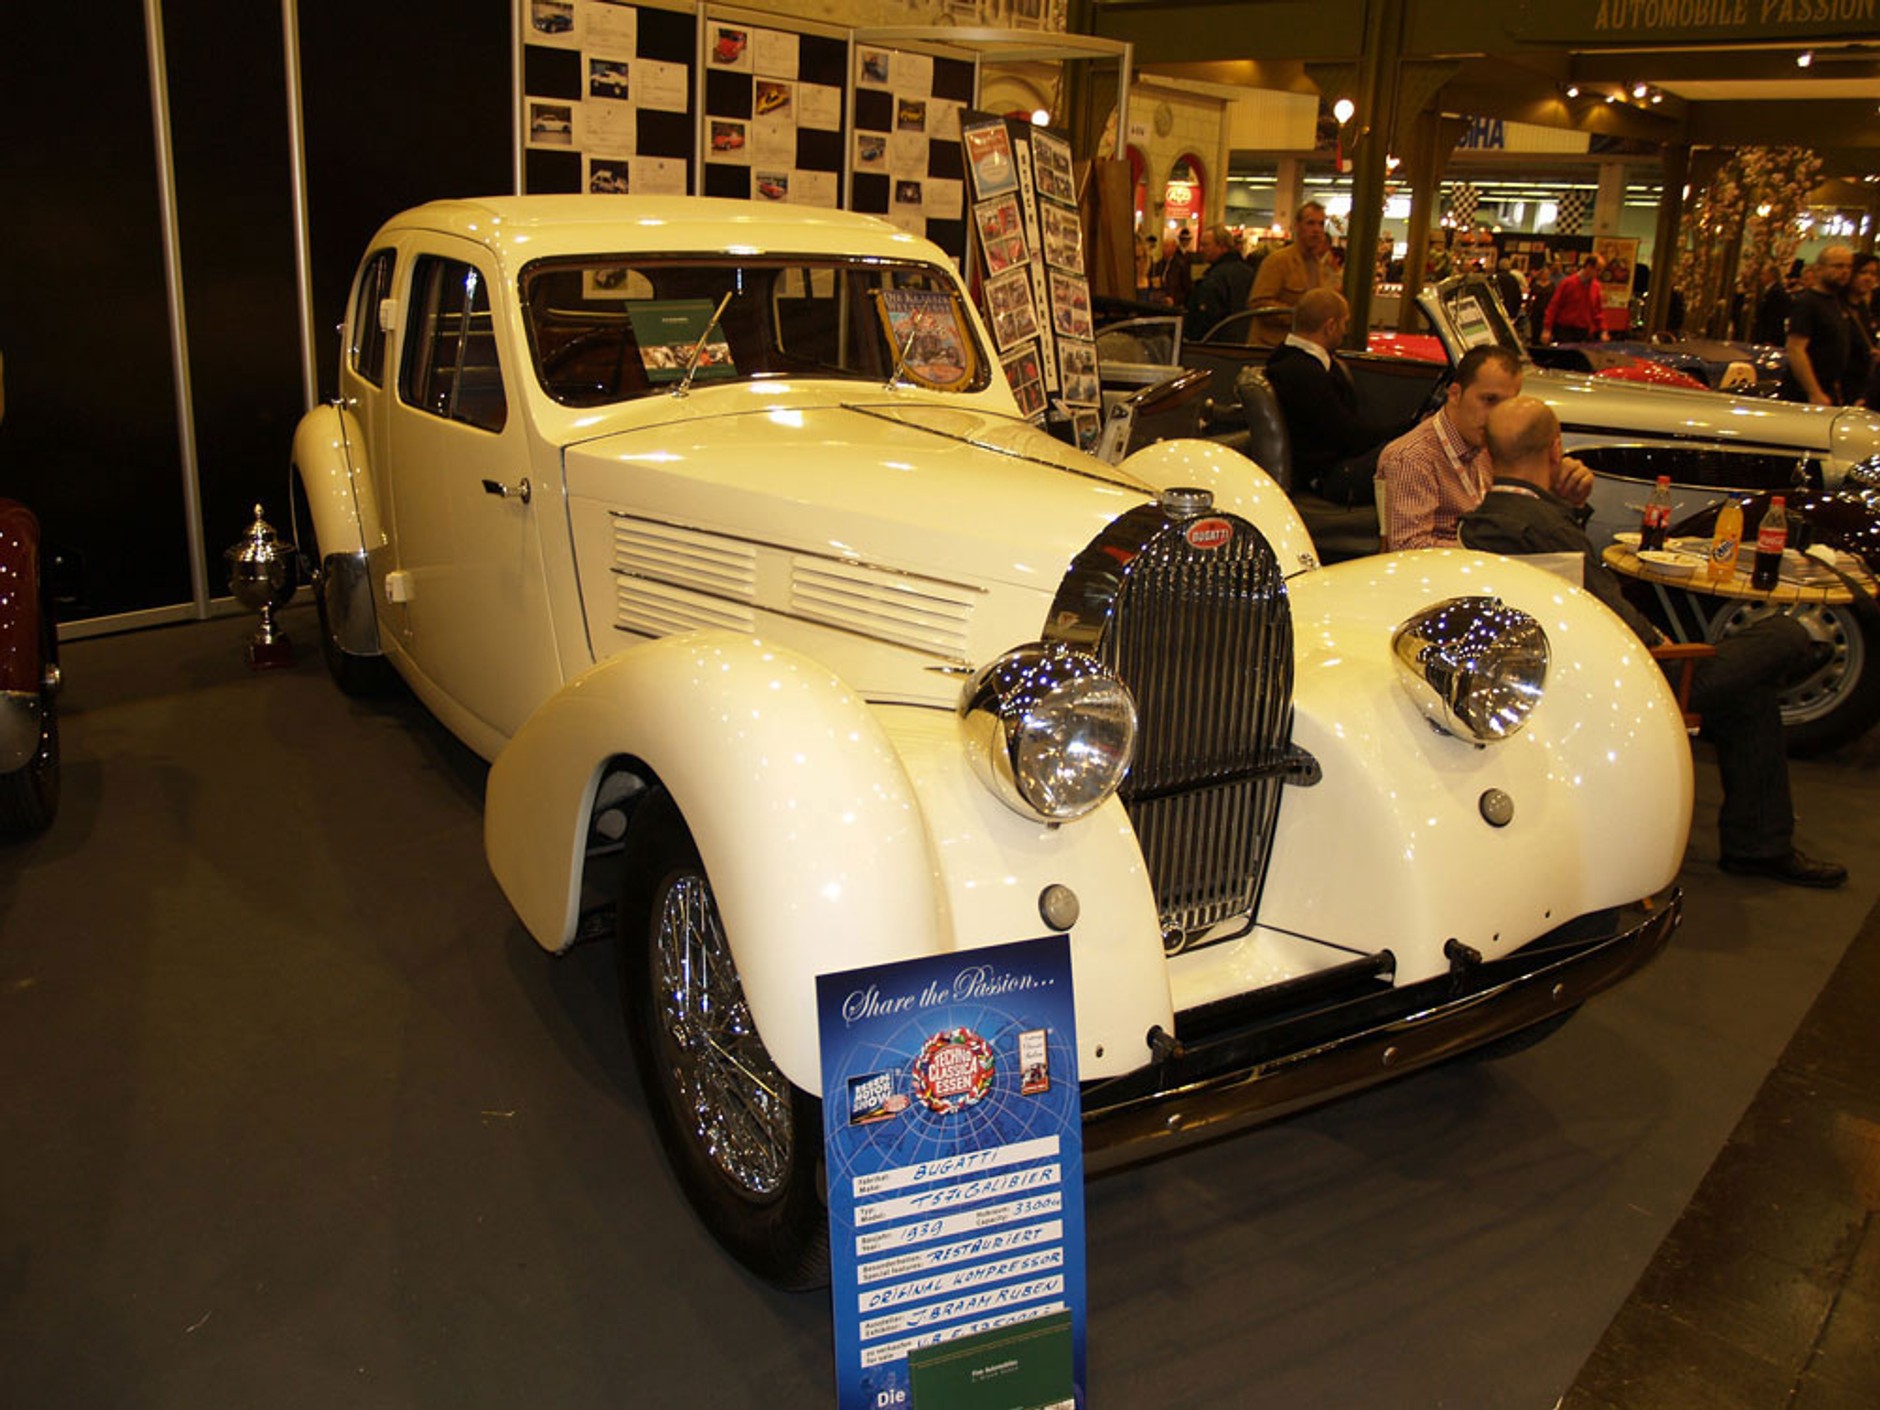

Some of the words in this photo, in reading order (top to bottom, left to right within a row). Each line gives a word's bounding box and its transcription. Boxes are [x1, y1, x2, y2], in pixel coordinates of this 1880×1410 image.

[1594, 0, 1747, 30] AUTOMOBILE
[1759, 0, 1877, 25] PASSION
[842, 983, 915, 1028] Share
[919, 980, 949, 1010] the
[953, 964, 1055, 1001] Passion...
[928, 1056, 977, 1083] CLASSICA
[936, 1075, 972, 1094] ESSEN
[913, 1150, 998, 1181] BUGATTI
[900, 1220, 944, 1242] 1939
[926, 1228, 1043, 1263] RESTAURIERT
[868, 1279, 944, 1308] ORIGINAL
[953, 1252, 1061, 1286] KOMPRESSOR
[997, 1279, 1060, 1301] RUBEN
[877, 1389, 906, 1408] Die
